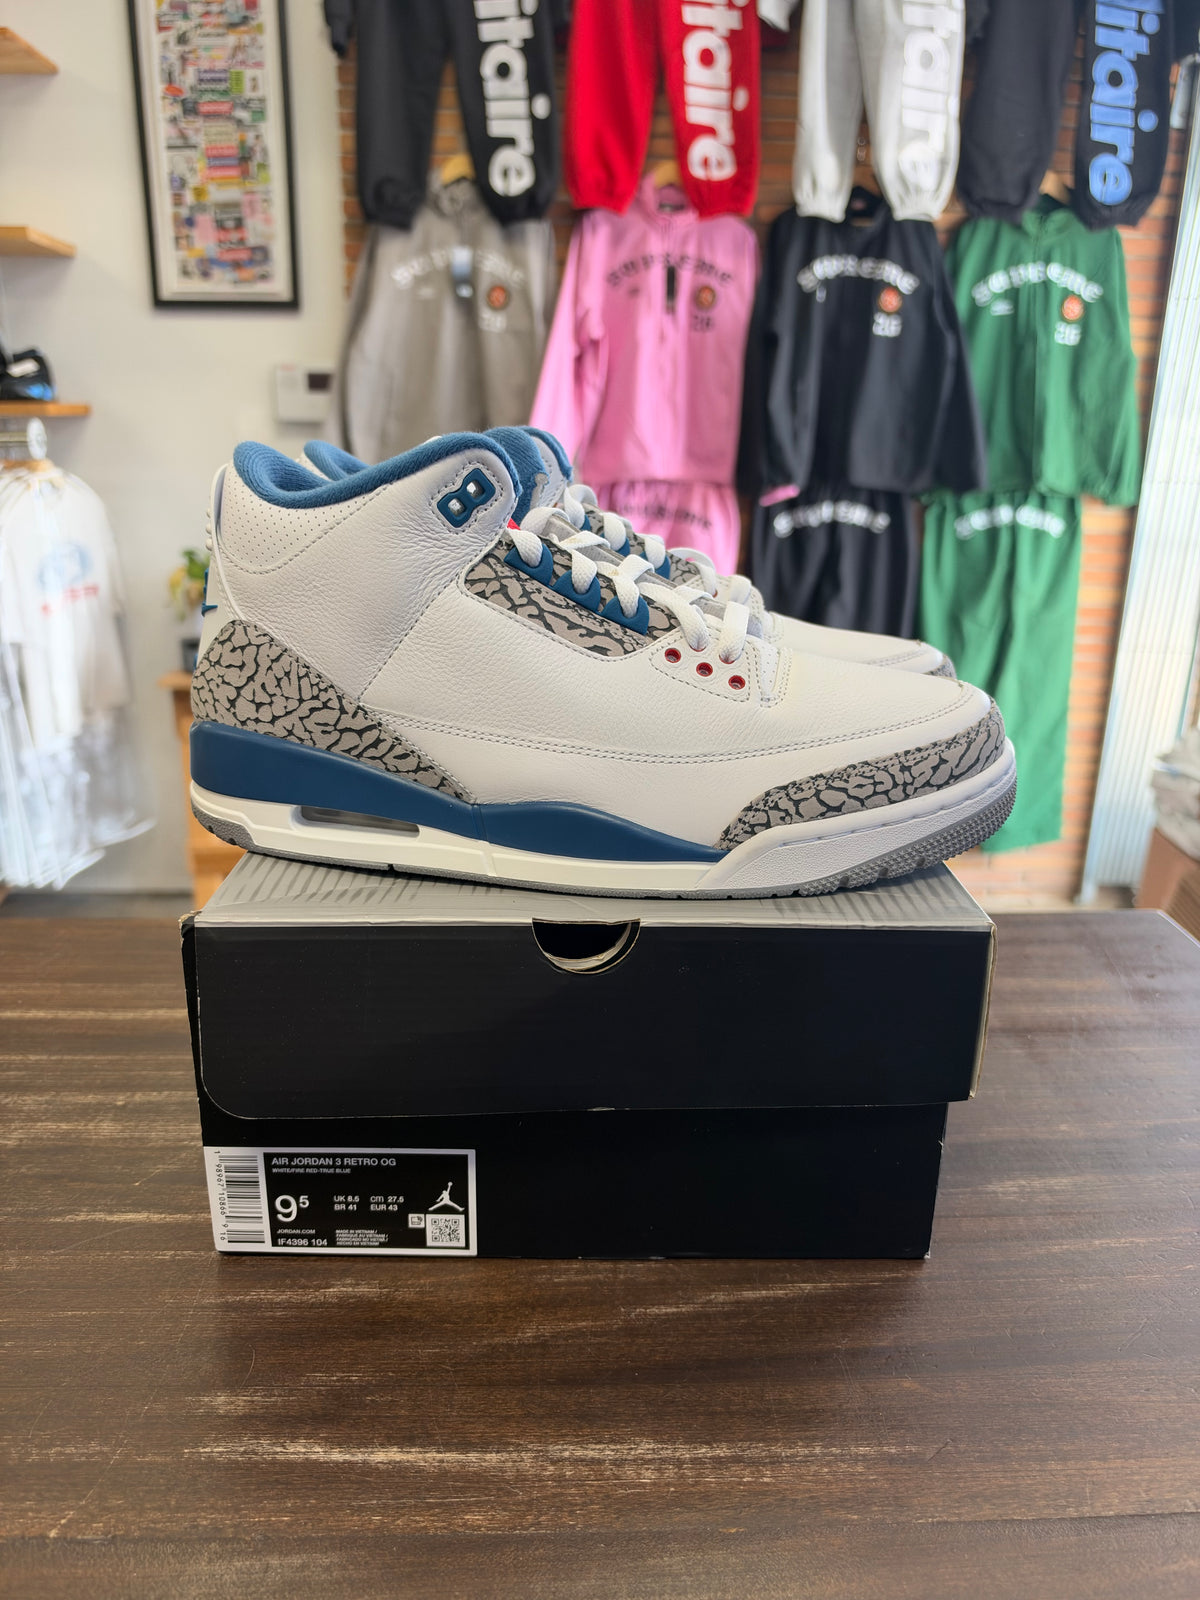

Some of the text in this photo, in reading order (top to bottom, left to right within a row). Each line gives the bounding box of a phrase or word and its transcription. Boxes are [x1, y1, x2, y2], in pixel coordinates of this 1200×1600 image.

[473, 0, 551, 197] itaire
[899, 0, 963, 191] taire
[271, 1157, 397, 1166] AIR JORDAN 3 RETRO OG
[277, 1238, 328, 1246] IF4396 104
